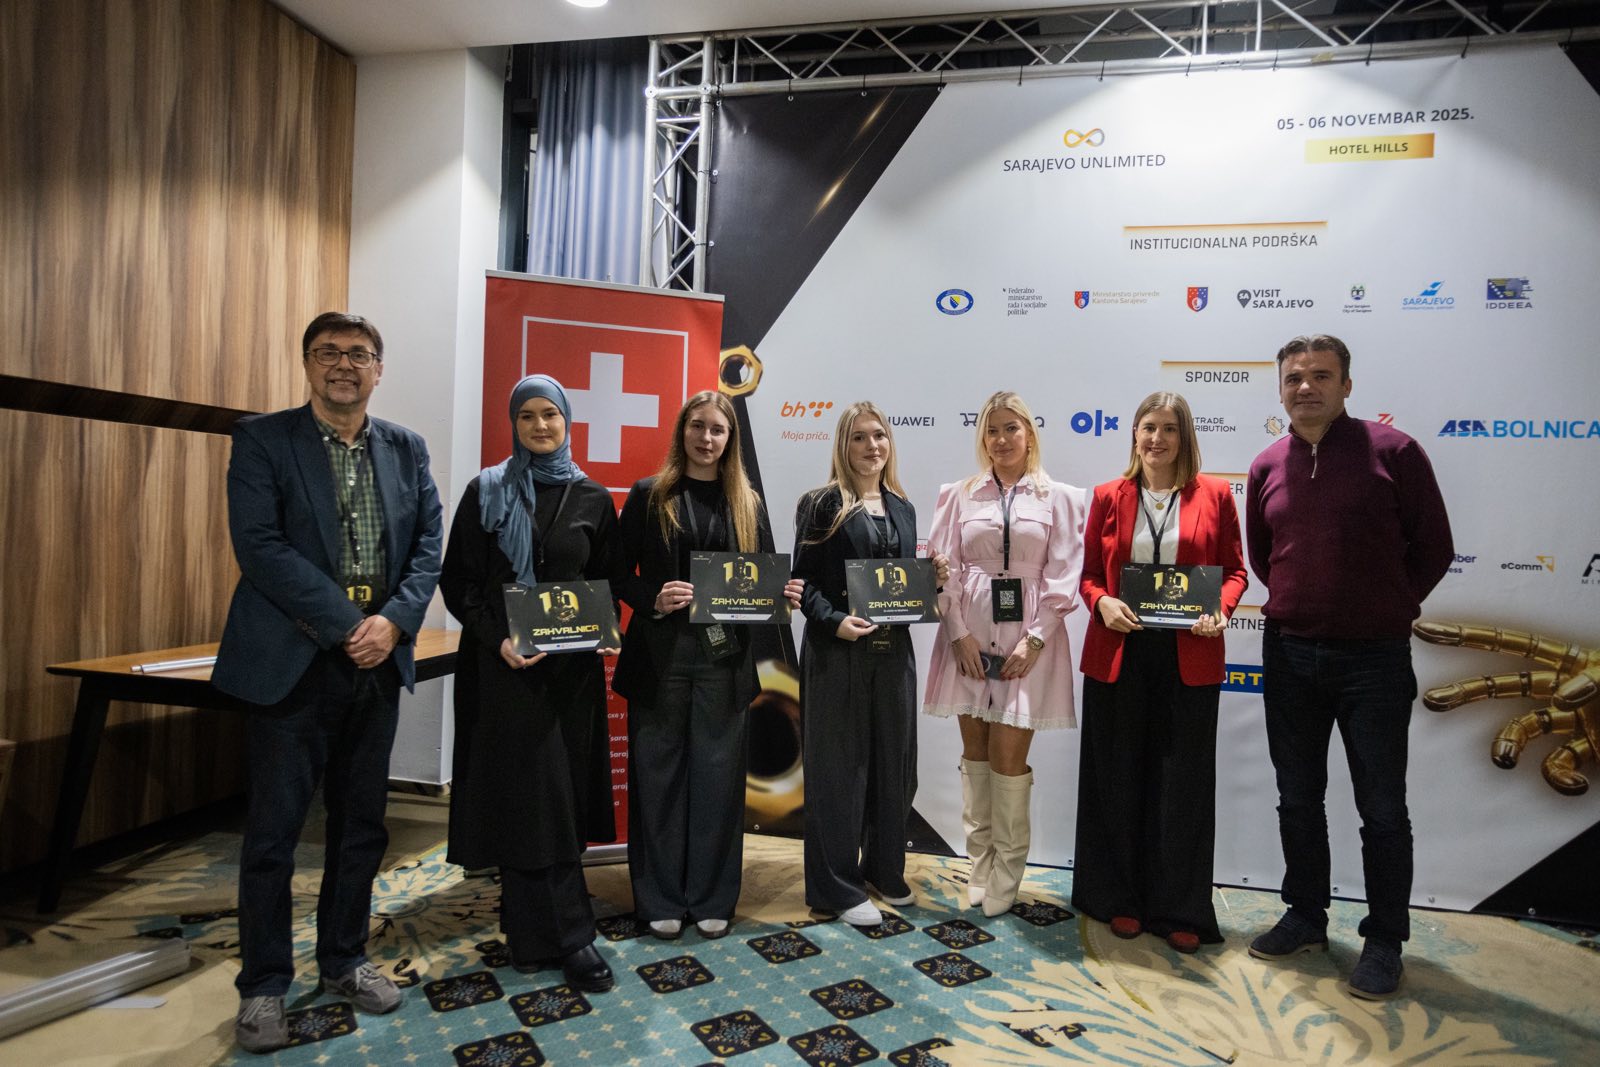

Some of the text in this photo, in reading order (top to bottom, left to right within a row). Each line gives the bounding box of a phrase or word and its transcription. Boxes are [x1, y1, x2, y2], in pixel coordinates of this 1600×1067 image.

[1277, 118, 1294, 130] 05
[1308, 116, 1327, 129] 06
[1331, 111, 1426, 127] NOVEMBAR
[1430, 107, 1475, 122] 2025.
[1329, 142, 1409, 155] HOTEL HILLS
[1003, 154, 1166, 173] SARAJEVO UNLIMITED
[1130, 232, 1318, 251] INSTITUCIONALNA PODRŠKA
[1253, 289, 1281, 298] VISIT
[1120, 297, 1147, 305] Sarajevo
[1252, 299, 1314, 309] SARAJEVO
[1403, 297, 1455, 306] SARAJEVO
[1485, 301, 1533, 310] IDDEEA
[1007, 309, 1028, 317] politike
[1185, 371, 1250, 383] SPONZOR
[780, 401, 806, 418] bh
[1194, 416, 1225, 424] TRADE
[1194, 425, 1236, 433] RIBUTION
[1437, 419, 1600, 439] ASA BOLNICA
[781, 430, 804, 442] Moja
[1500, 561, 1543, 571] eComm
[711, 597, 774, 606] ZAHVALNICA
[868, 600, 923, 609] ZAHVALNICA
[1140, 602, 1203, 612] ZAHVALNICA
[532, 624, 600, 637] ZAHVALNICA
